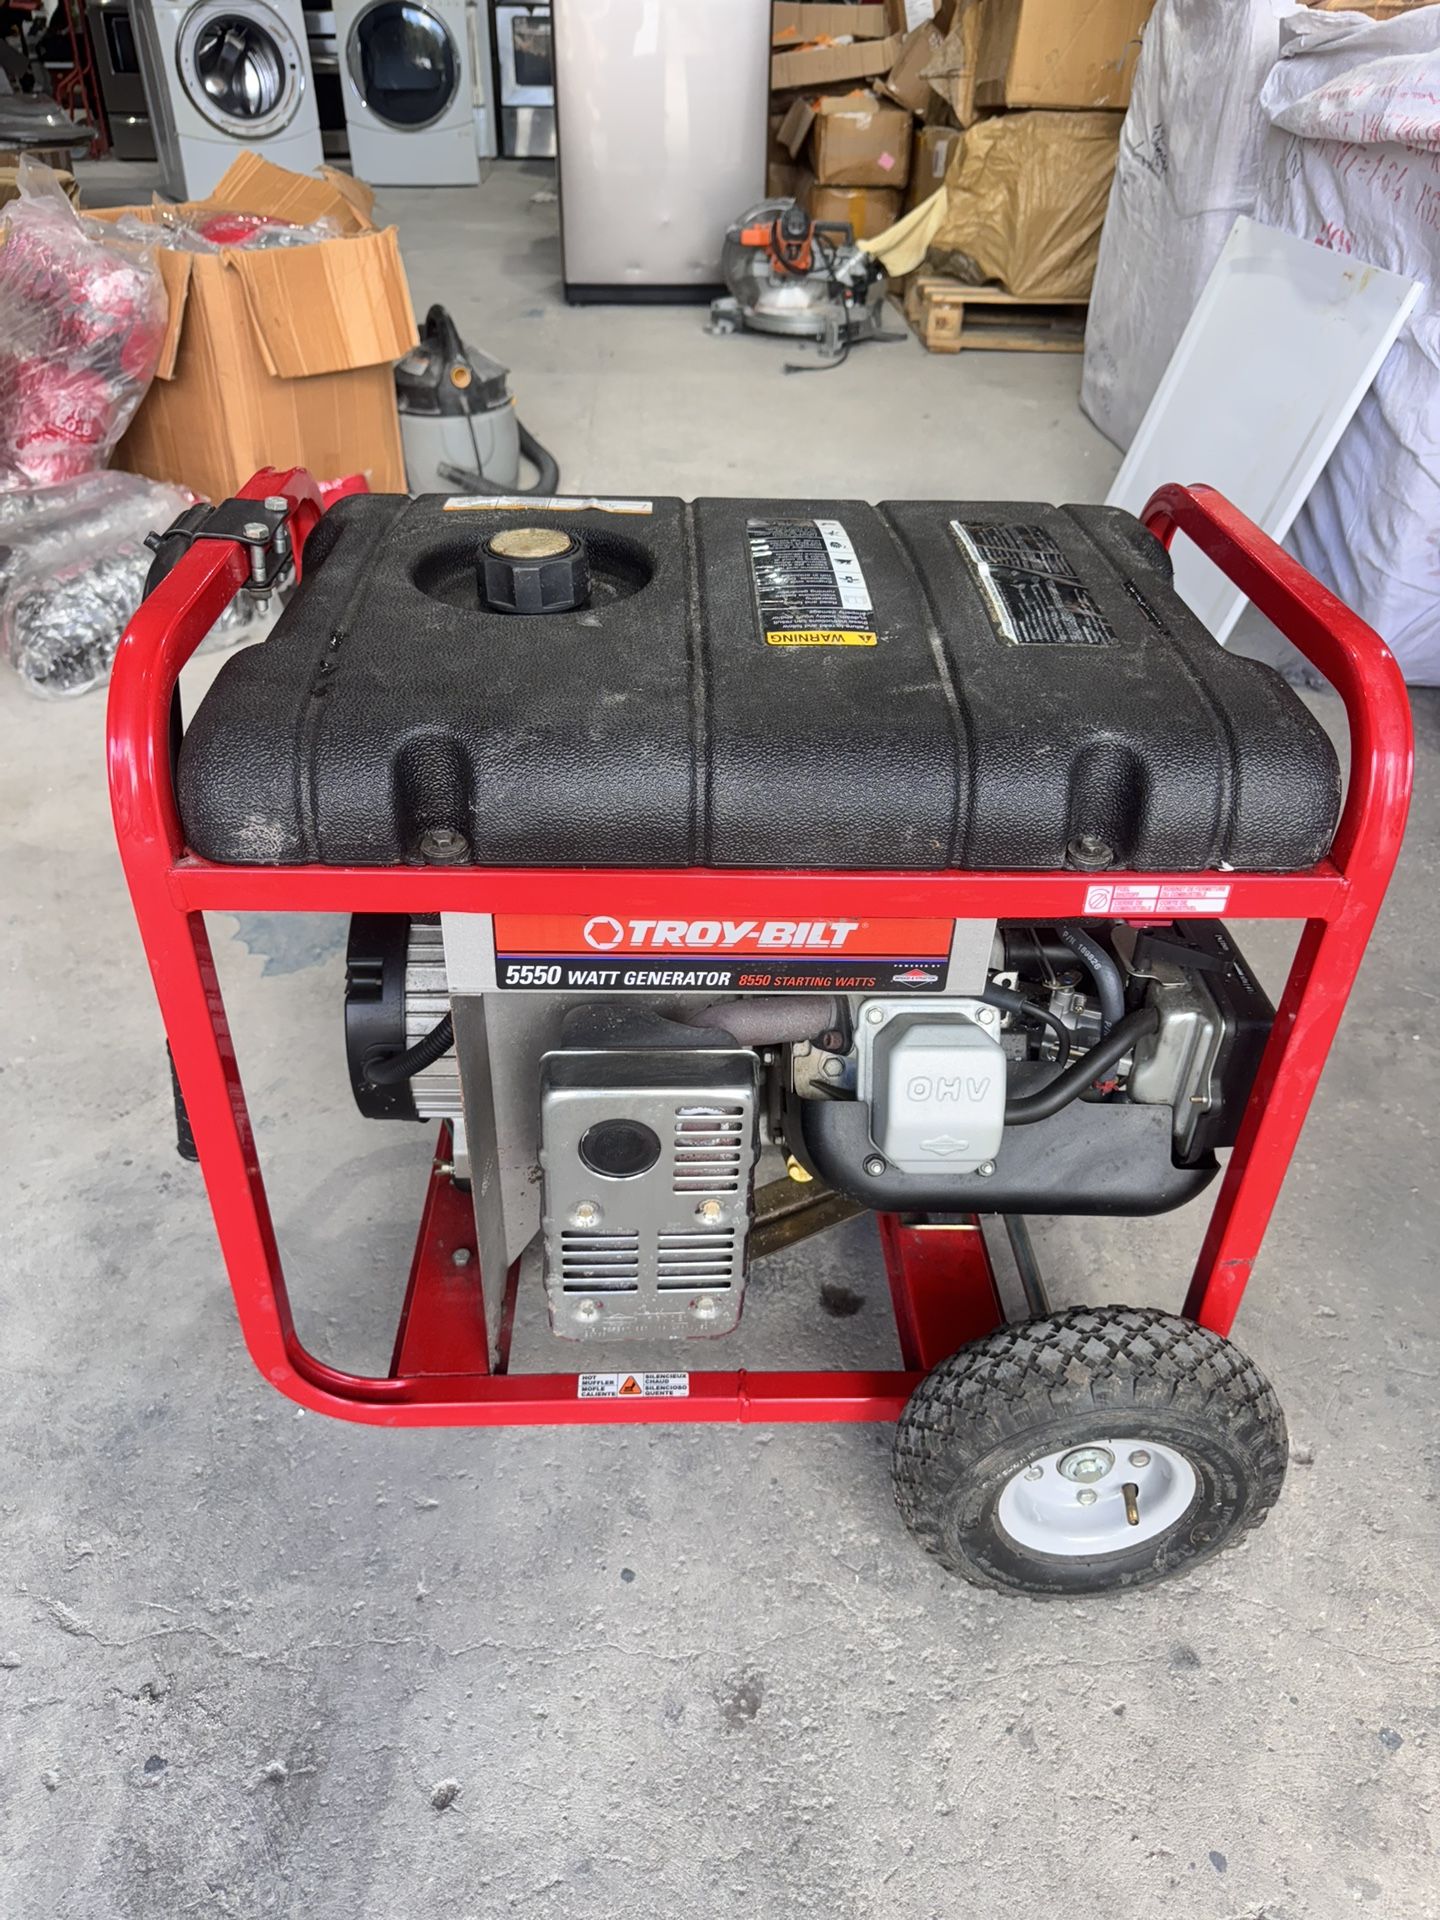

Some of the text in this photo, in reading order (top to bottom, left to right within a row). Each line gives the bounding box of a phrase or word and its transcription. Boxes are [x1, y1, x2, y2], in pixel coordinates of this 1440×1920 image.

[770, 634, 845, 643] WARNING
[628, 920, 860, 948] TROY-BILT
[505, 965, 732, 986] 5550 WATT GENERATOR
[738, 974, 876, 987] 8550 STARTING WATTS
[906, 1076, 991, 1102] OHV
